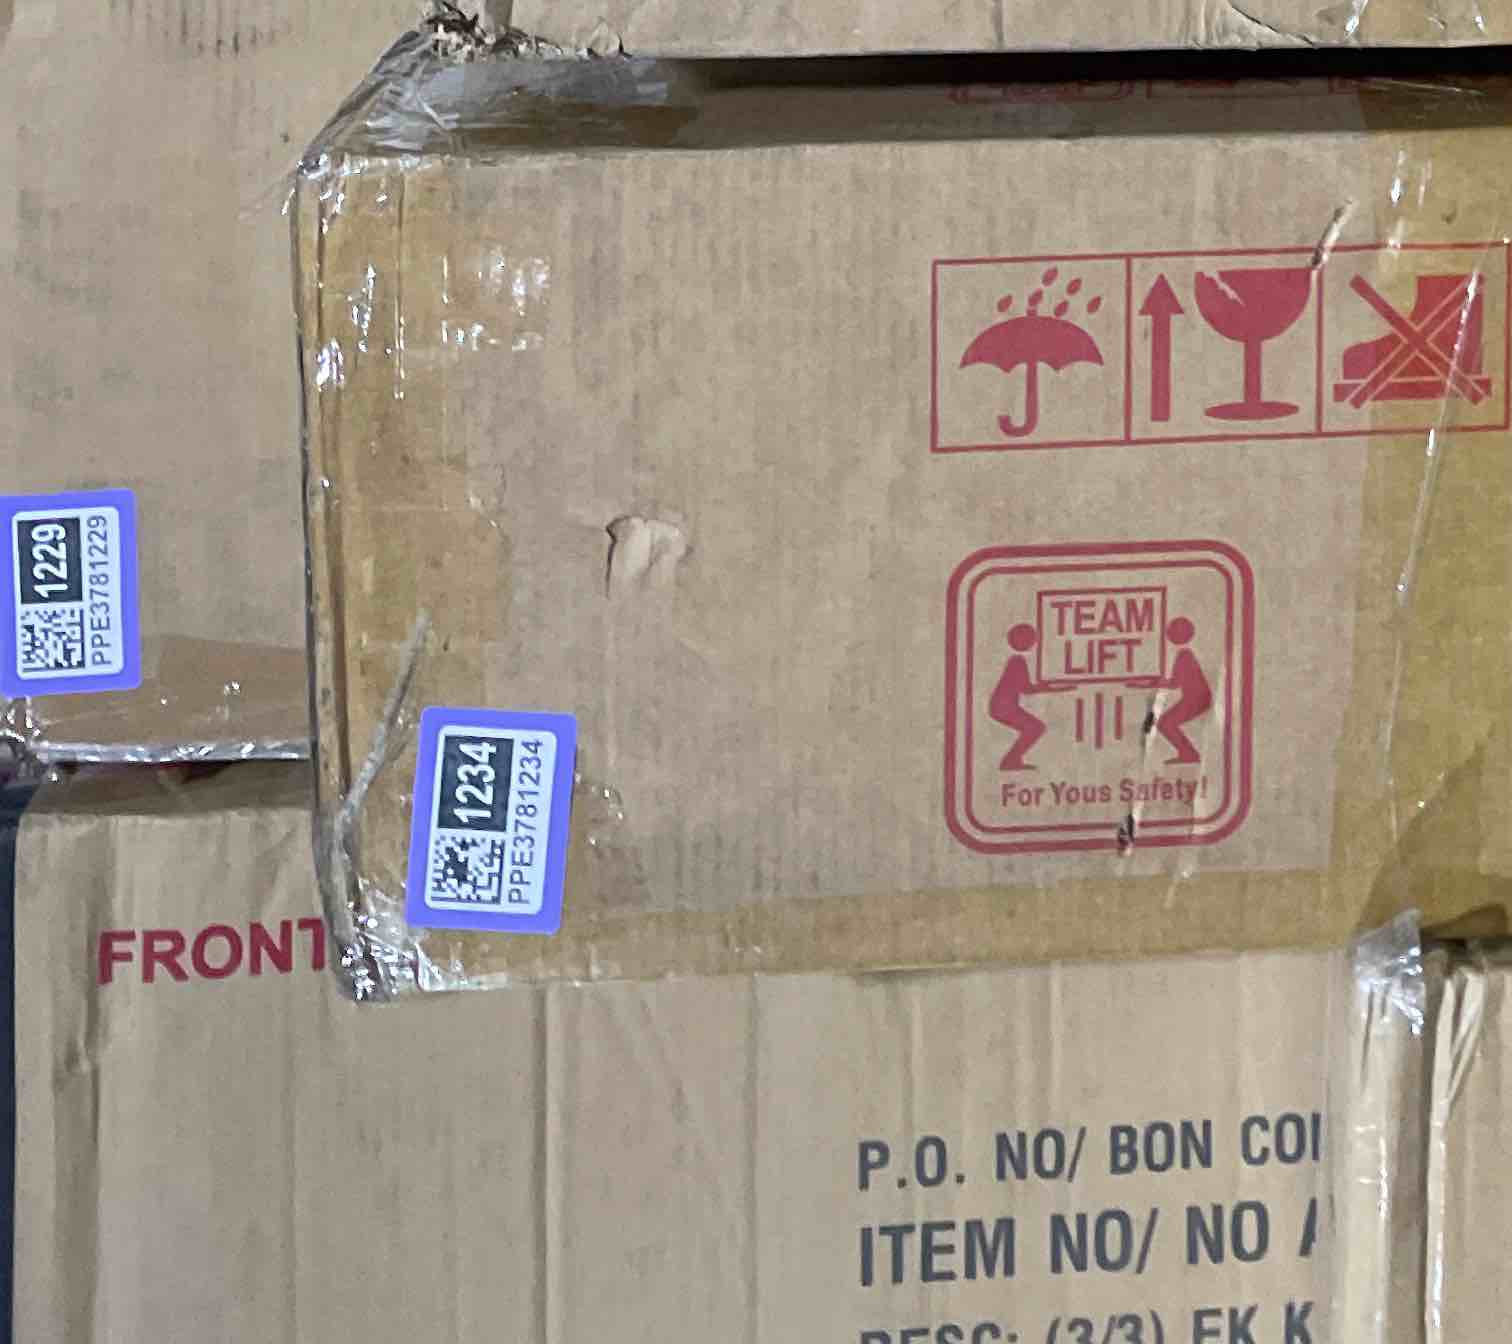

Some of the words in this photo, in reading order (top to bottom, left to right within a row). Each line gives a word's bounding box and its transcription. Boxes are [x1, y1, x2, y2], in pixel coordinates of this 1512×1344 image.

[31, 523, 69, 599] 1229
[86, 514, 113, 666] PPE3781229
[1051, 597, 1154, 636] TEAM
[1063, 639, 1143, 675] LIFT
[452, 741, 497, 824] 1234
[1000, 782, 1045, 808] For
[507, 738, 545, 905] PPE3781234
[97, 917, 327, 987] FRONT
[857, 1135, 966, 1192] P.O.
[1108, 1119, 1214, 1176] BON
[859, 1216, 1016, 1288] ITEM
[1185, 1199, 1271, 1266] NO
